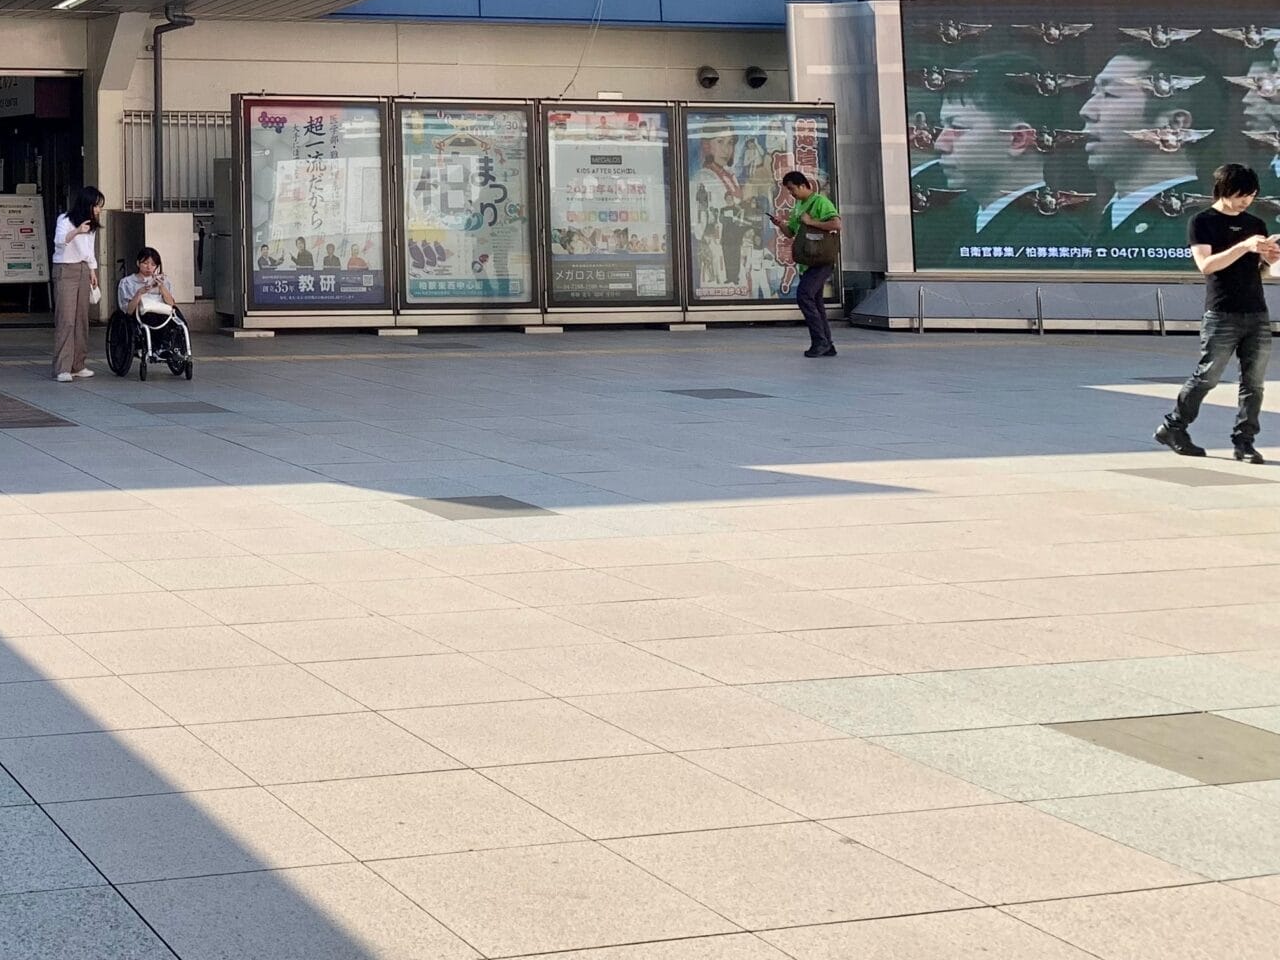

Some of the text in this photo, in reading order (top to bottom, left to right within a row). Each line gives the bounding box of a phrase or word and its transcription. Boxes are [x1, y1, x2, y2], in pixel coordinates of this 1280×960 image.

[303, 115, 327, 230] 超一流だから
[471, 155, 508, 227] まつり
[298, 274, 336, 293] 教研
